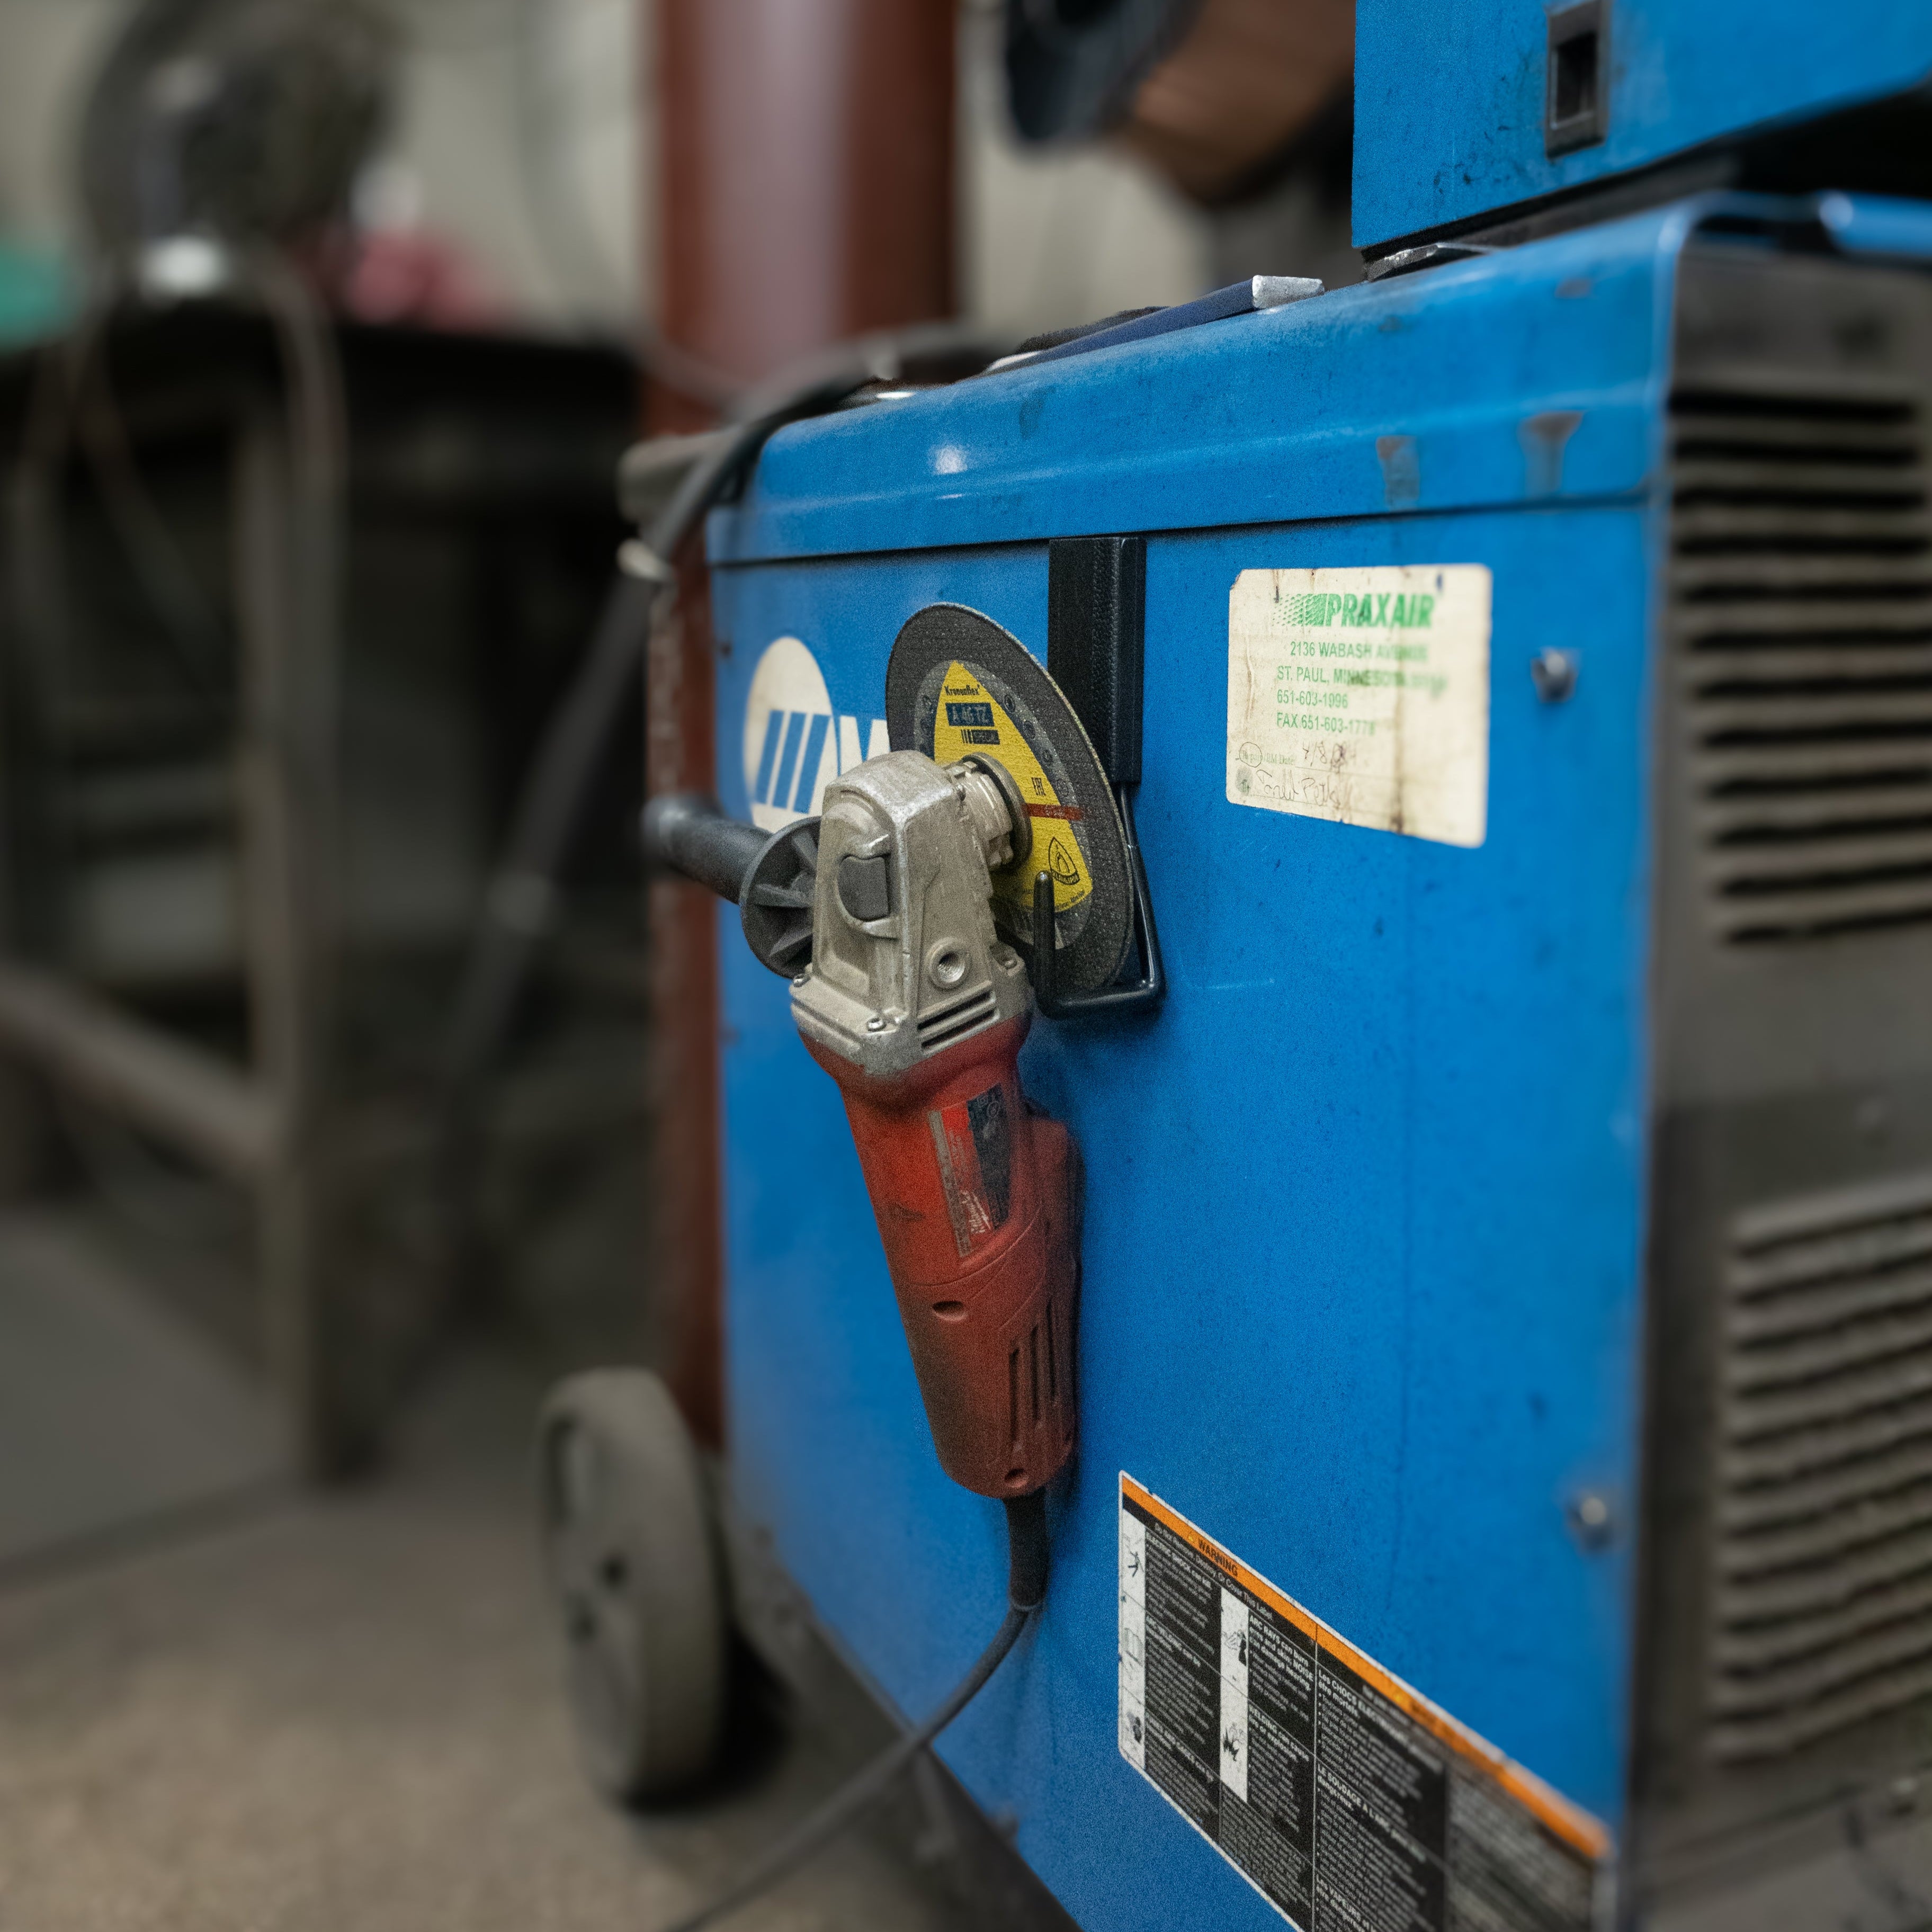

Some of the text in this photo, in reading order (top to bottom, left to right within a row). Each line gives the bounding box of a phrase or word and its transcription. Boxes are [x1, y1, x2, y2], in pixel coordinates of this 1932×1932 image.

[1325, 593, 1434, 627] PRAXAIR
[1290, 641, 1315, 656] 2136
[1319, 642, 1371, 658] WABASH
[1277, 666, 1293, 681] ST.
[1296, 667, 1329, 684] PAUL,
[1277, 712, 1298, 728] FAX
[1198, 1537, 1238, 1578] WARNING
